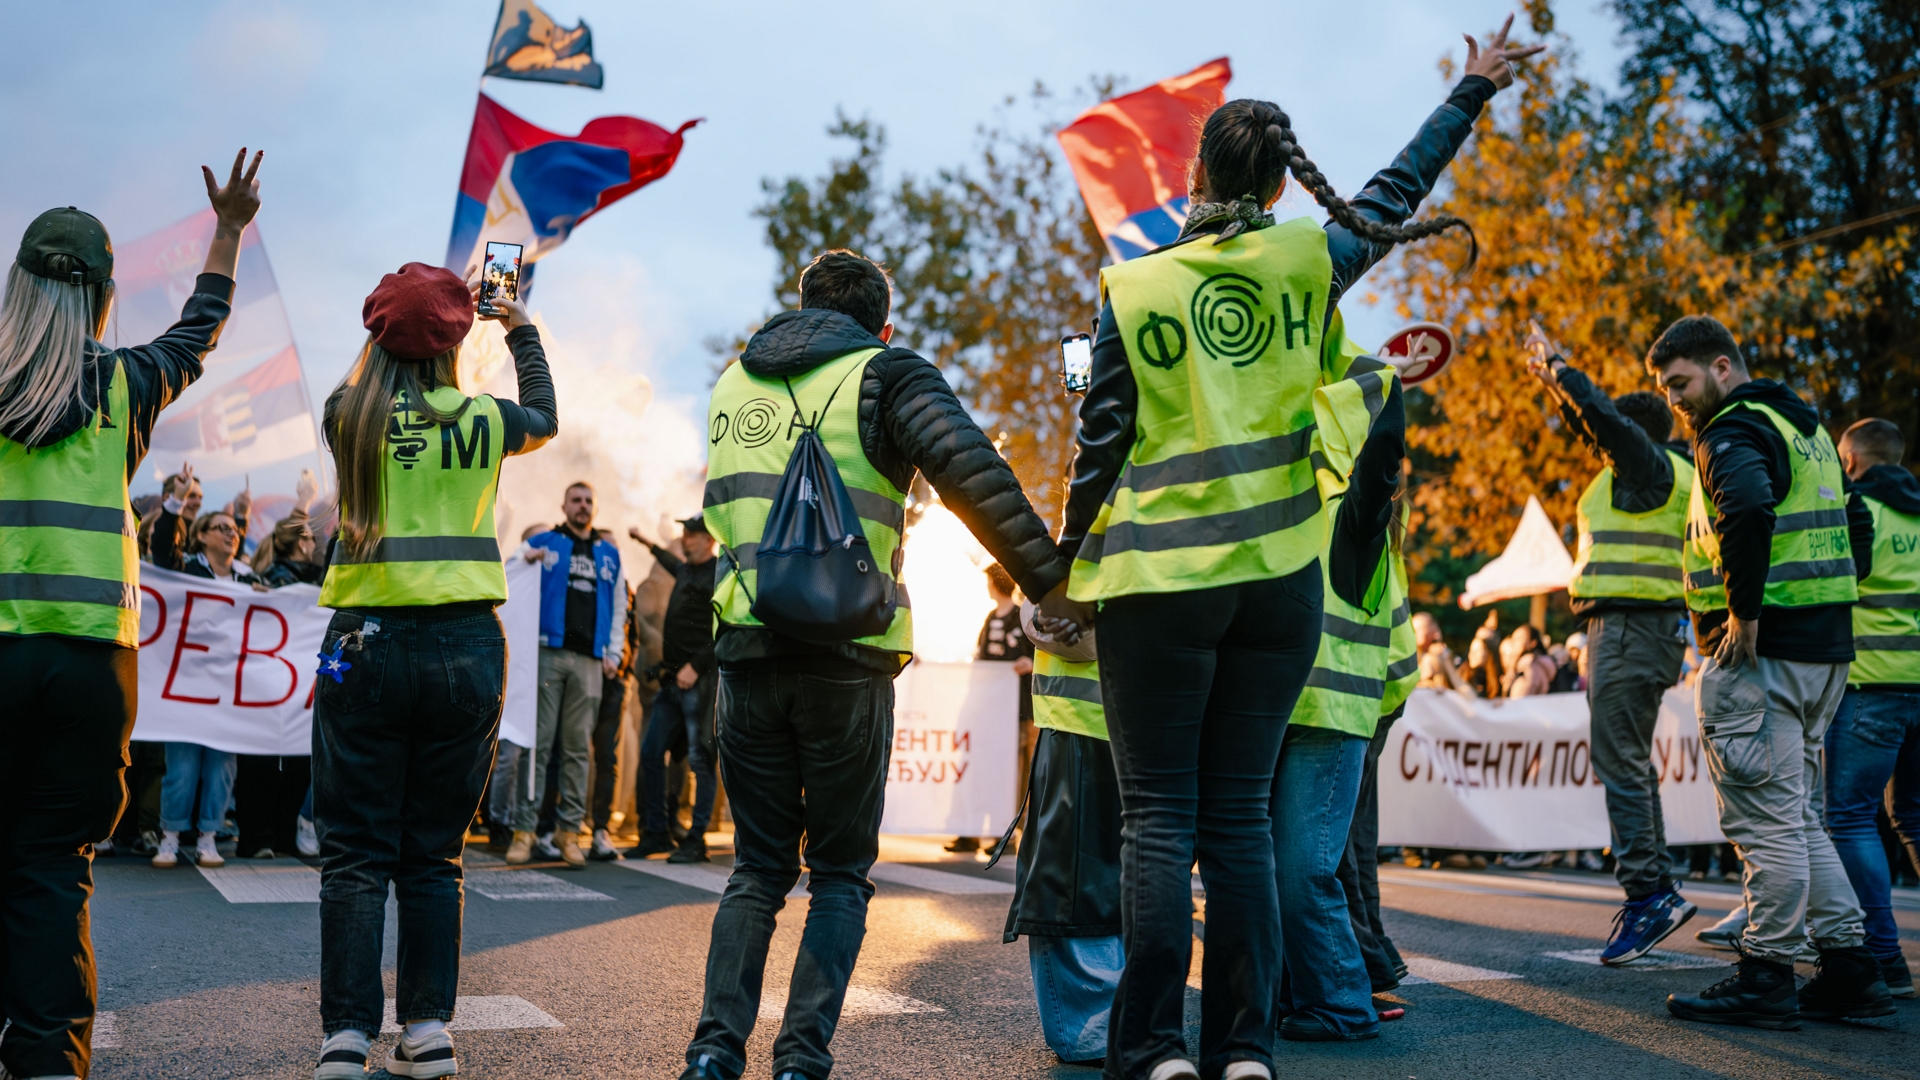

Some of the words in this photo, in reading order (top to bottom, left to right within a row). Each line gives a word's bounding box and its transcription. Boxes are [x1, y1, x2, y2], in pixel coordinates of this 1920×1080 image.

[895, 728, 971, 753] ЕНТИ
[886, 759, 970, 784] ЂУЈУ
[1400, 732, 1543, 788] СДЕНТИ
[1550, 737, 1700, 788] ПОУЈУ
